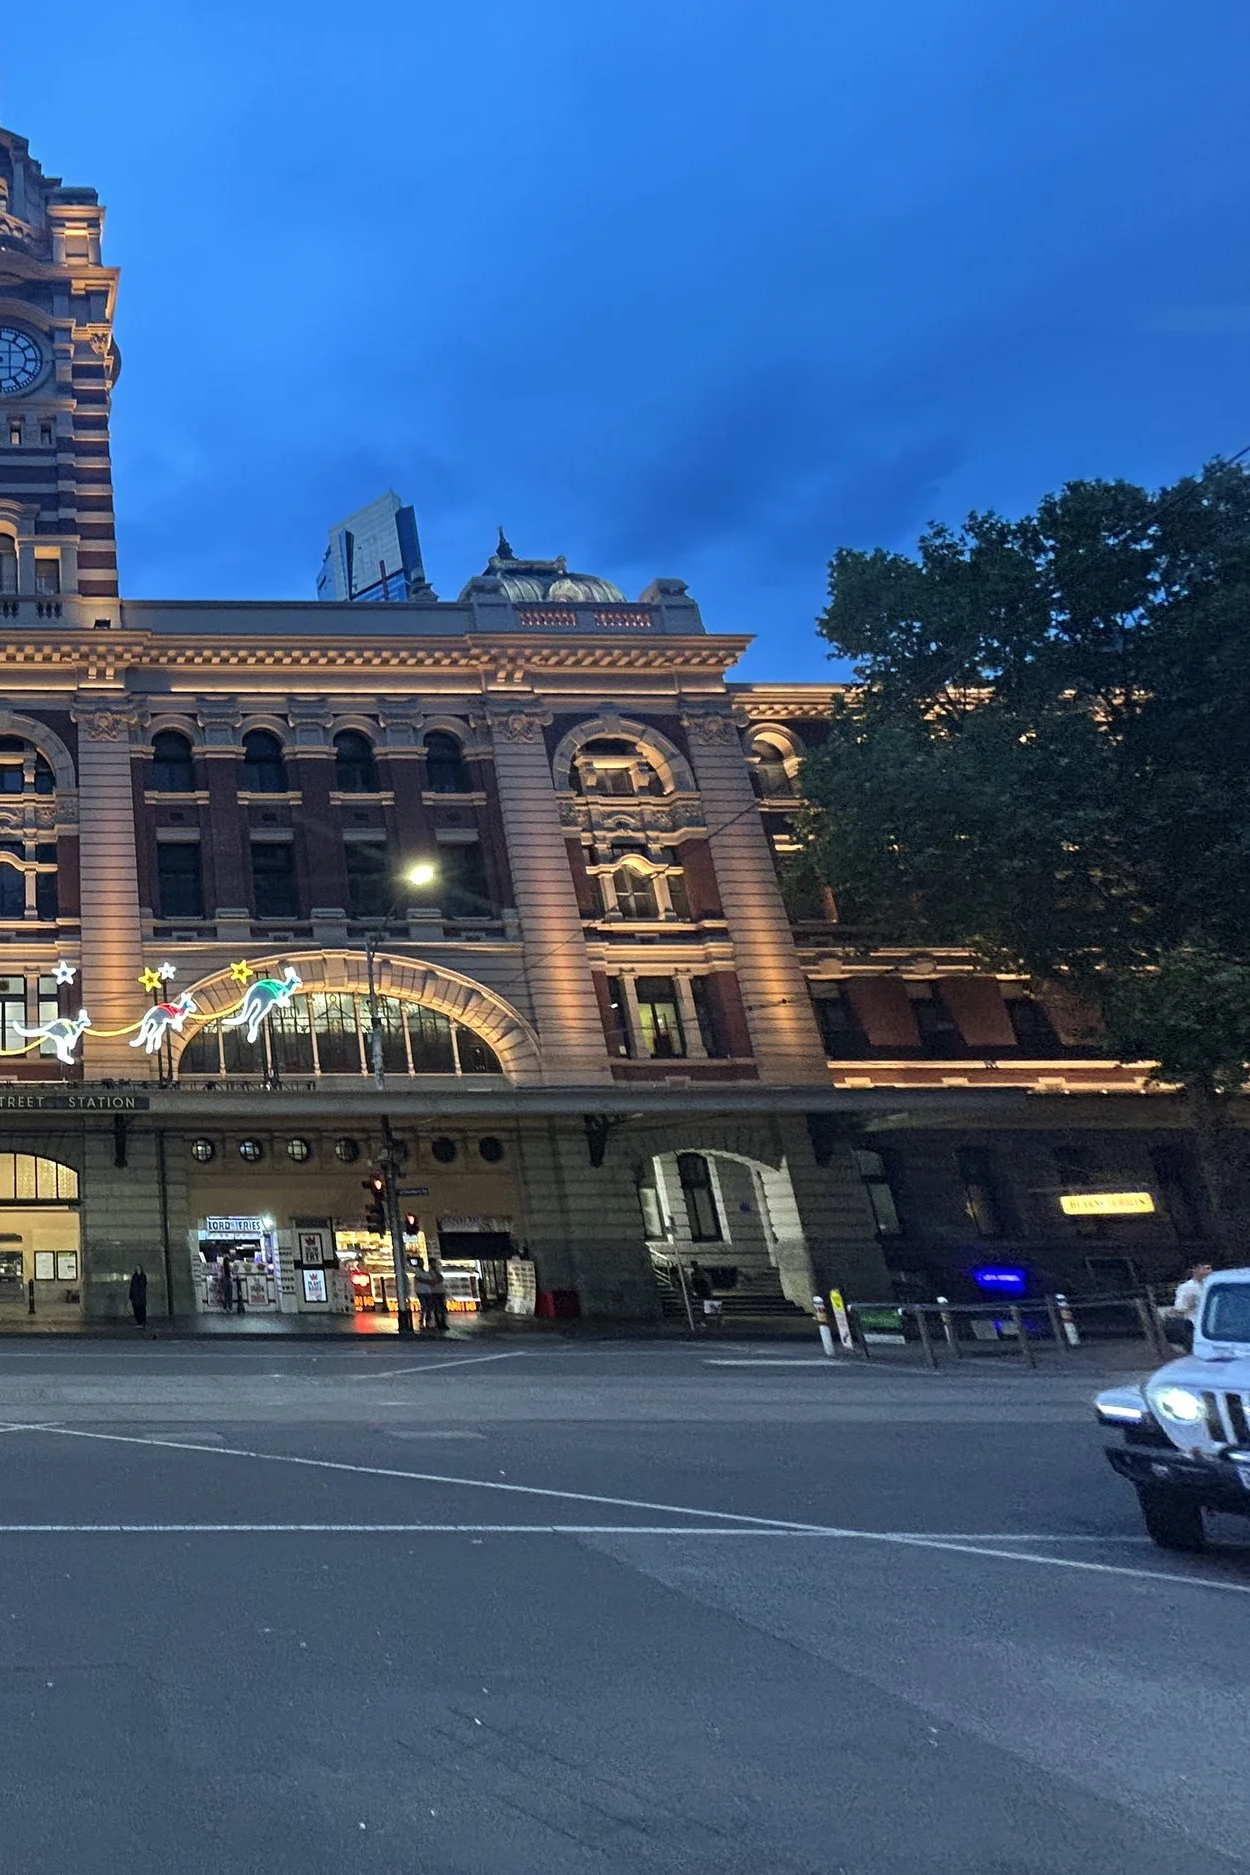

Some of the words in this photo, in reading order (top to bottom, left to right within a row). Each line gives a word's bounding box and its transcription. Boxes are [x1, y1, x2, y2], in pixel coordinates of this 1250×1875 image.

[68, 1096, 135, 1108] STATION
[208, 1221, 230, 1230] LORD
[238, 1221, 260, 1230] FRIES
